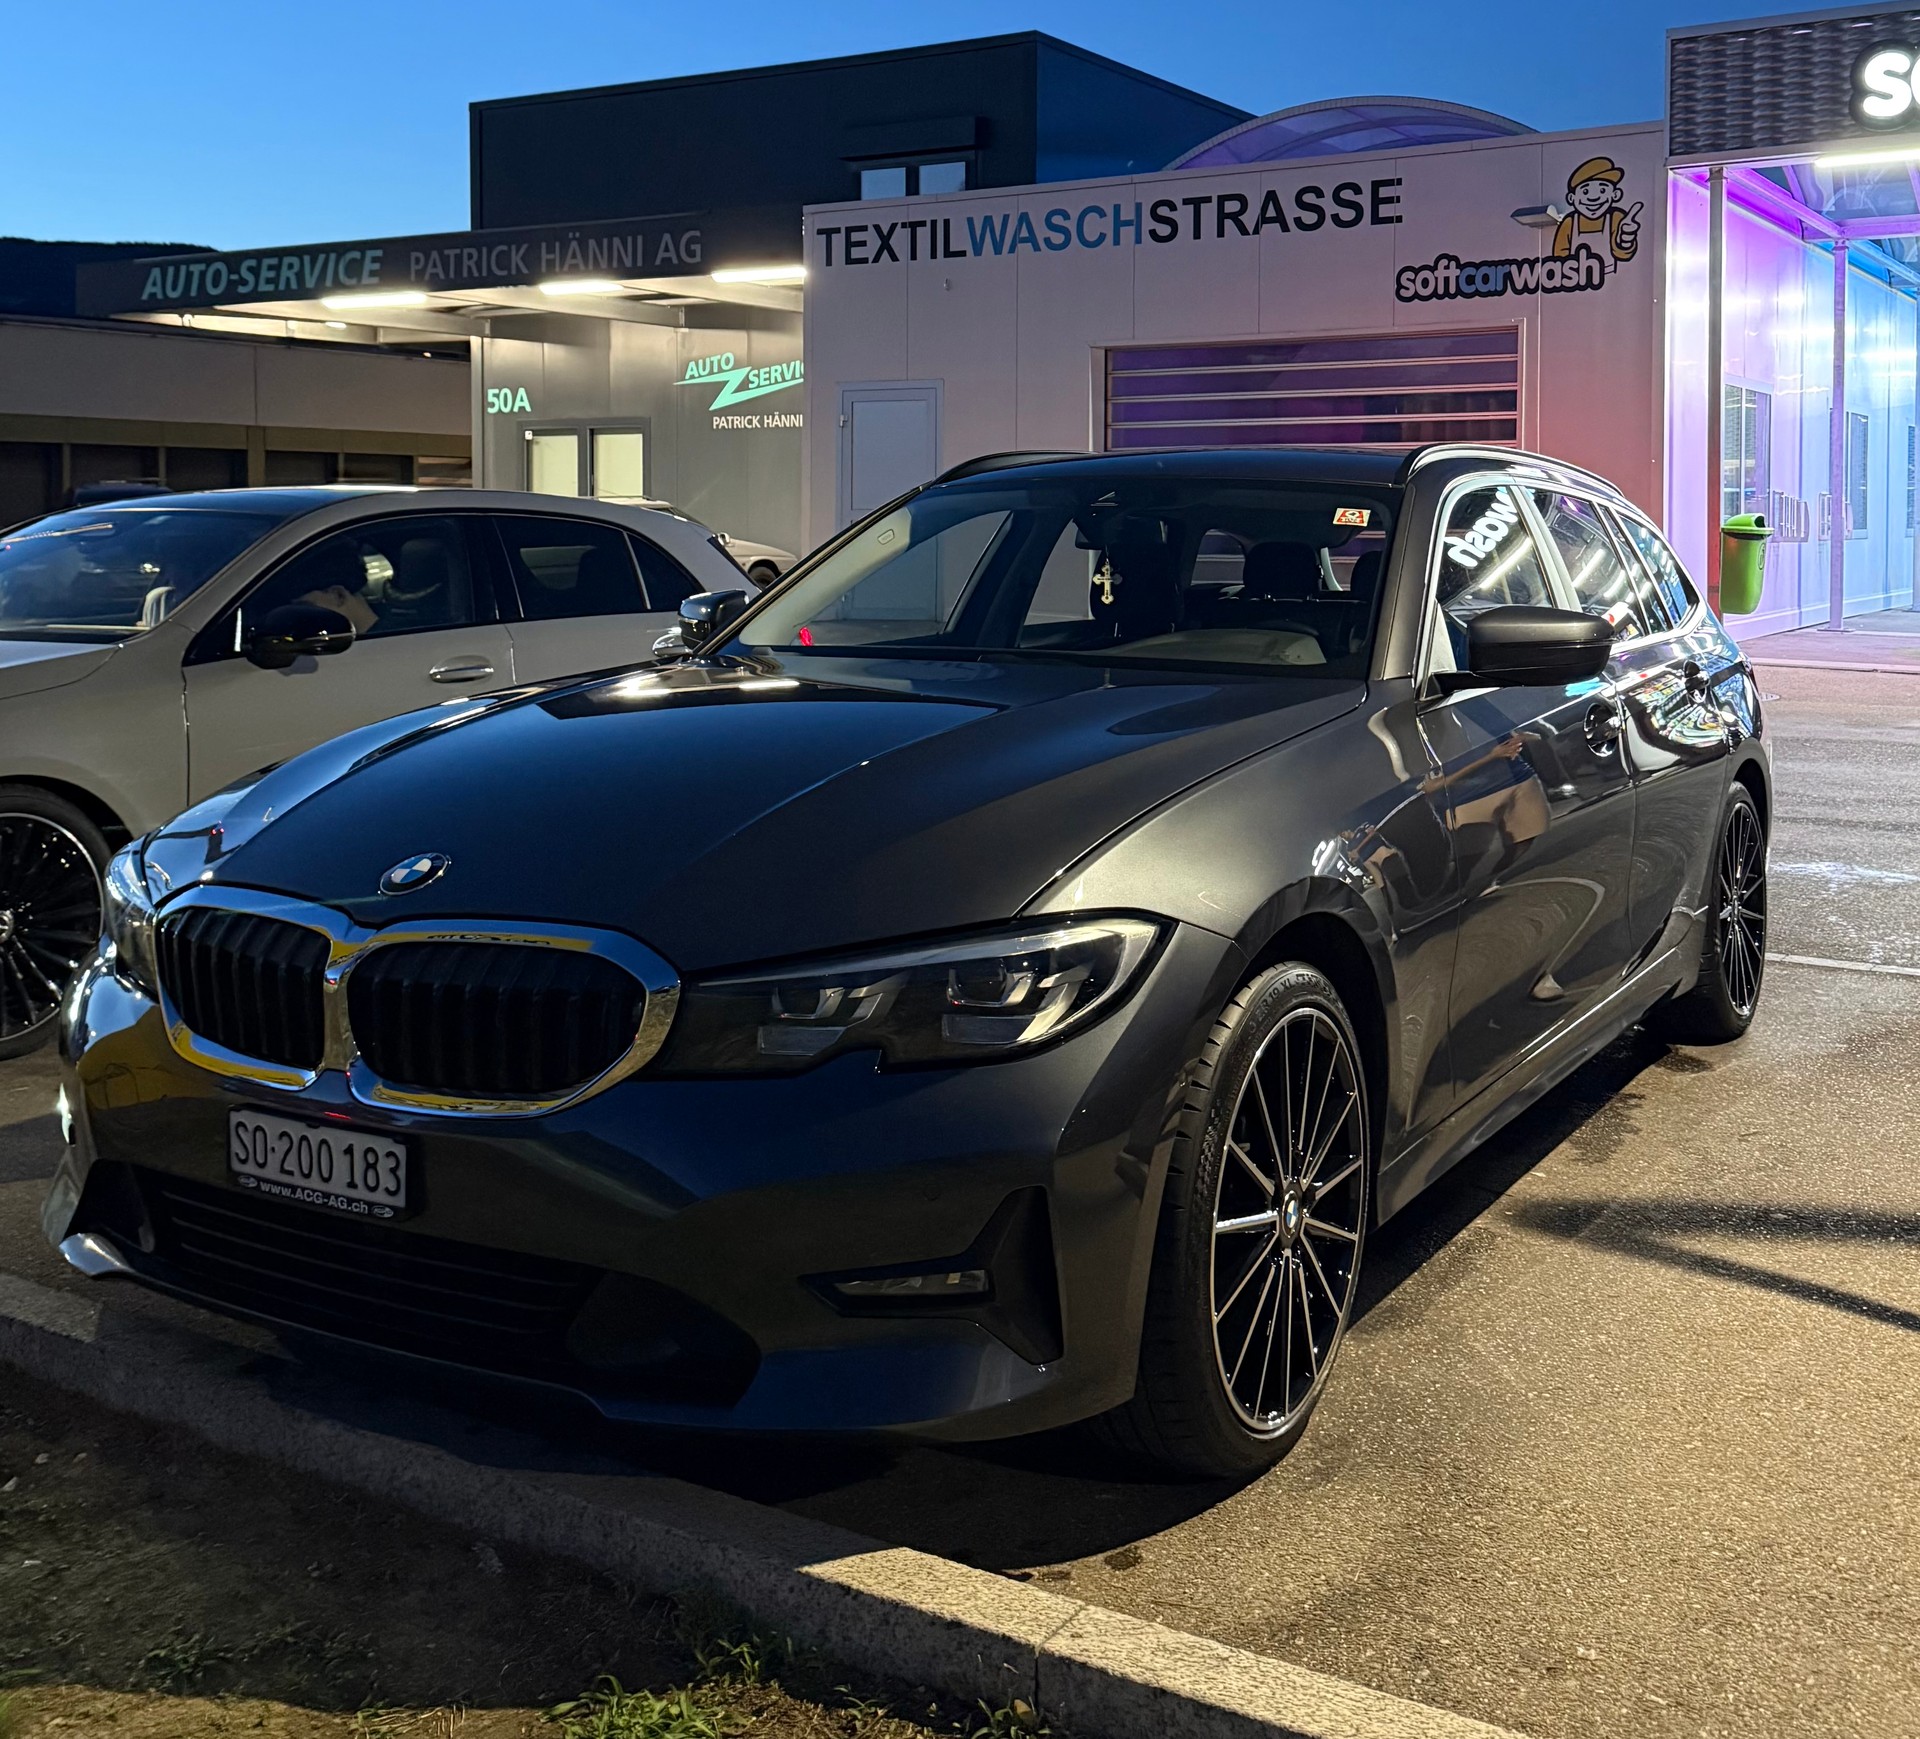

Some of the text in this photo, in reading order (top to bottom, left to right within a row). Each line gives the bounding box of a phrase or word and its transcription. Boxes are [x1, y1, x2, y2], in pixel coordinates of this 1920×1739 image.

[816, 177, 1403, 267] TEXTILWASCHSTRASSE
[141, 230, 702, 300] AUTO-SERVICE PATRICK HÄNNI AG
[1398, 246, 1602, 299] softcarwash
[685, 352, 735, 380] AUTO
[487, 387, 532, 414] 50A
[712, 411, 803, 429] PATRICK HÄNNI
[343, 1142, 401, 1197] 183
[259, 1180, 369, 1214] www.ACG-AG.ch
